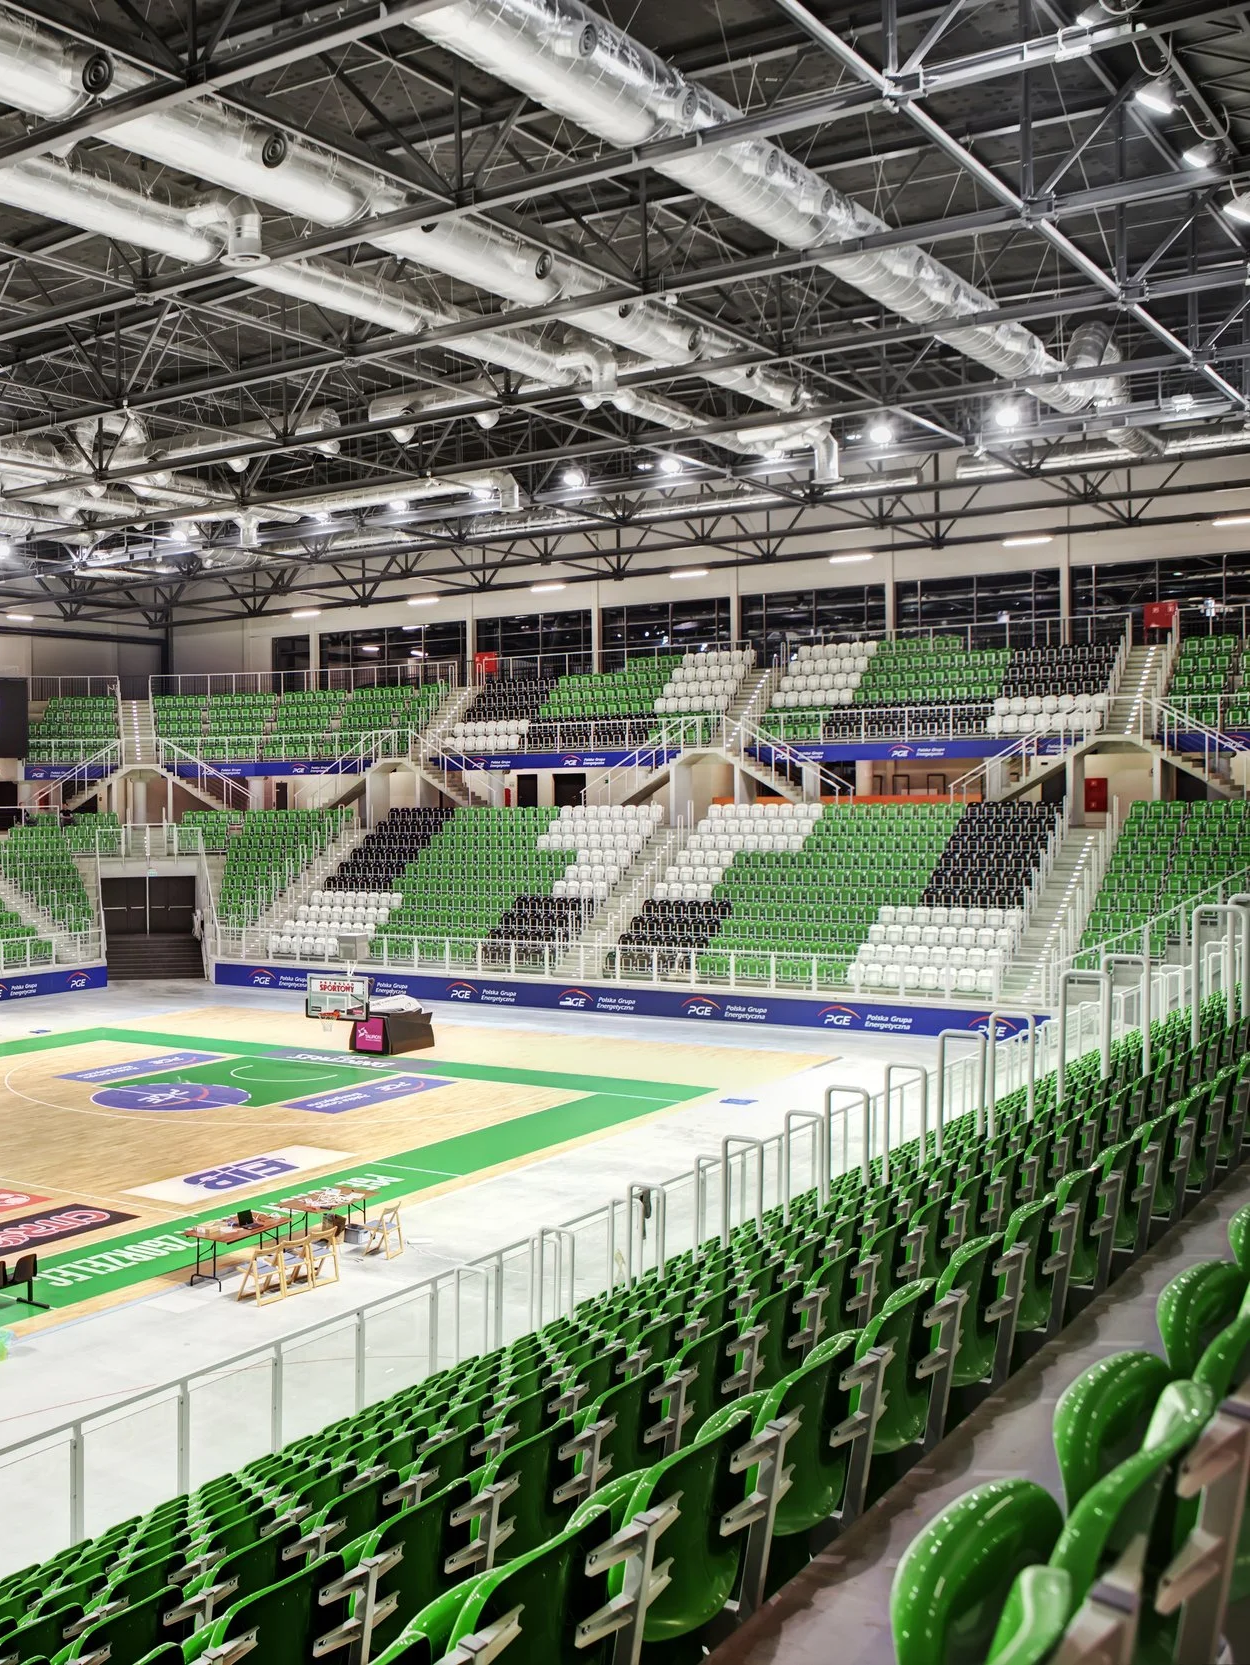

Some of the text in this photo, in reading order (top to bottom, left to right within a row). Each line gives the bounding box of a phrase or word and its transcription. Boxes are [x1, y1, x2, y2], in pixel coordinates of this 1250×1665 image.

[70, 978, 86, 988] PGE
[253, 976, 270, 985] PGE
[10, 988, 37, 997] Energetyczna
[451, 990, 471, 999] PGE
[482, 989, 517, 999] Polska Grupa
[481, 994, 516, 1003] Energetyczna
[617, 998, 636, 1006] Grupa
[597, 1003, 634, 1011] Energetyczna
[688, 1005, 712, 1016] PGE
[726, 1005, 768, 1015] Polska Grupa
[724, 1012, 766, 1020] Energetyczna
[824, 1015, 852, 1026] PGE
[866, 1014, 913, 1025] Polska Grupa
[865, 1021, 911, 1031] Energetyczna
[137, 1088, 190, 1104] PGE
[40, 1234, 203, 1287] ZGORZELEC
